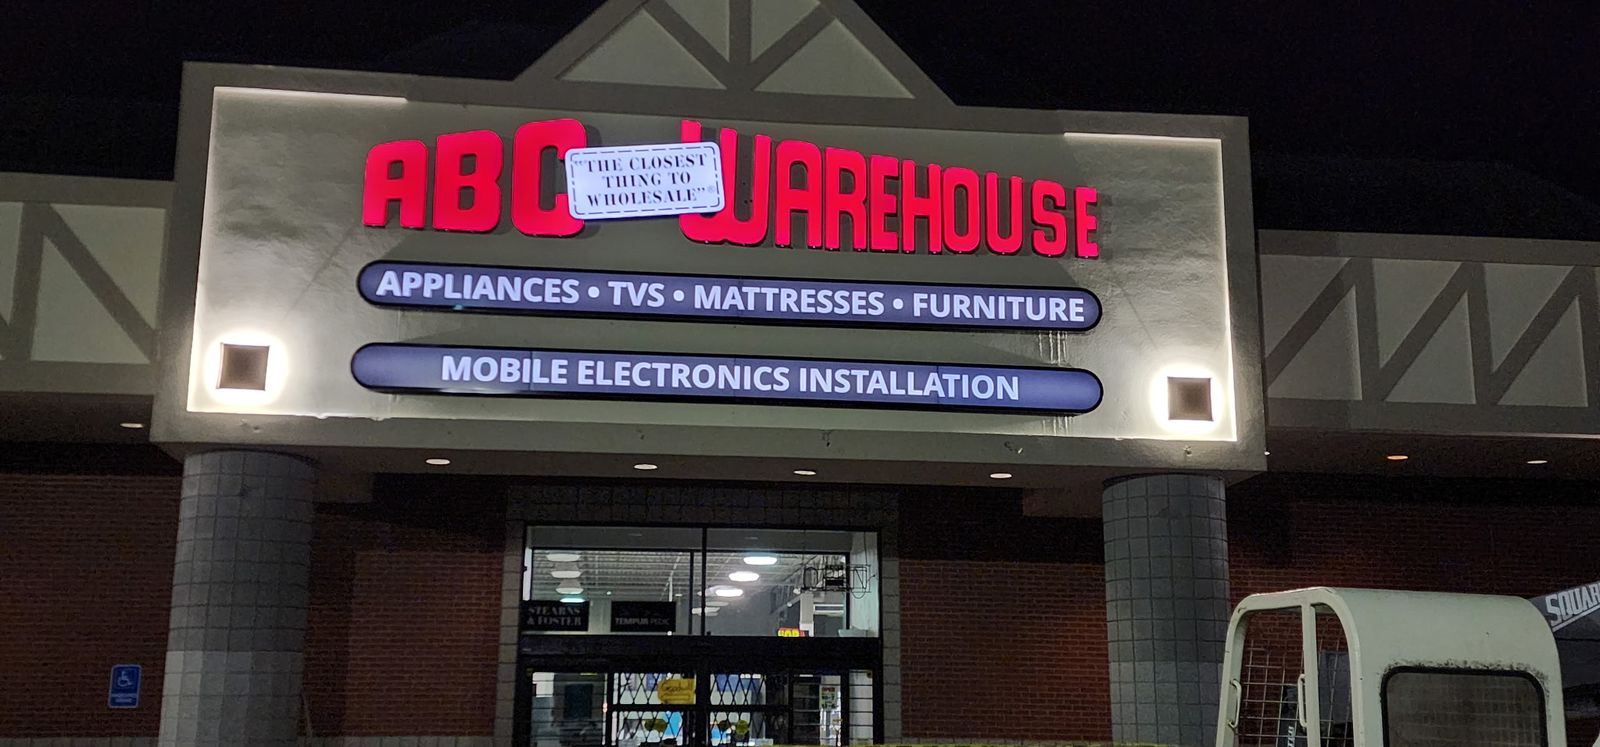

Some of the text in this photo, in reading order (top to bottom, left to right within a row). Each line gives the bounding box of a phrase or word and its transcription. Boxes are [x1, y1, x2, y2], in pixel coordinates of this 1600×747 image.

[629, 154, 708, 172] CLOSEST
[363, 118, 1099, 258] ABC WAREHOUSE
[602, 171, 691, 189] THING TO
[375, 270, 1085, 322] APPLIANCES TVS MATTRESSES FURNITURE
[441, 355, 1020, 400] MOBILE ELECTRONICS INSTALLATION
[528, 606, 581, 616] STEARNS
[1545, 582, 1600, 627] SQUAR
[537, 616, 582, 627] FOSTER
